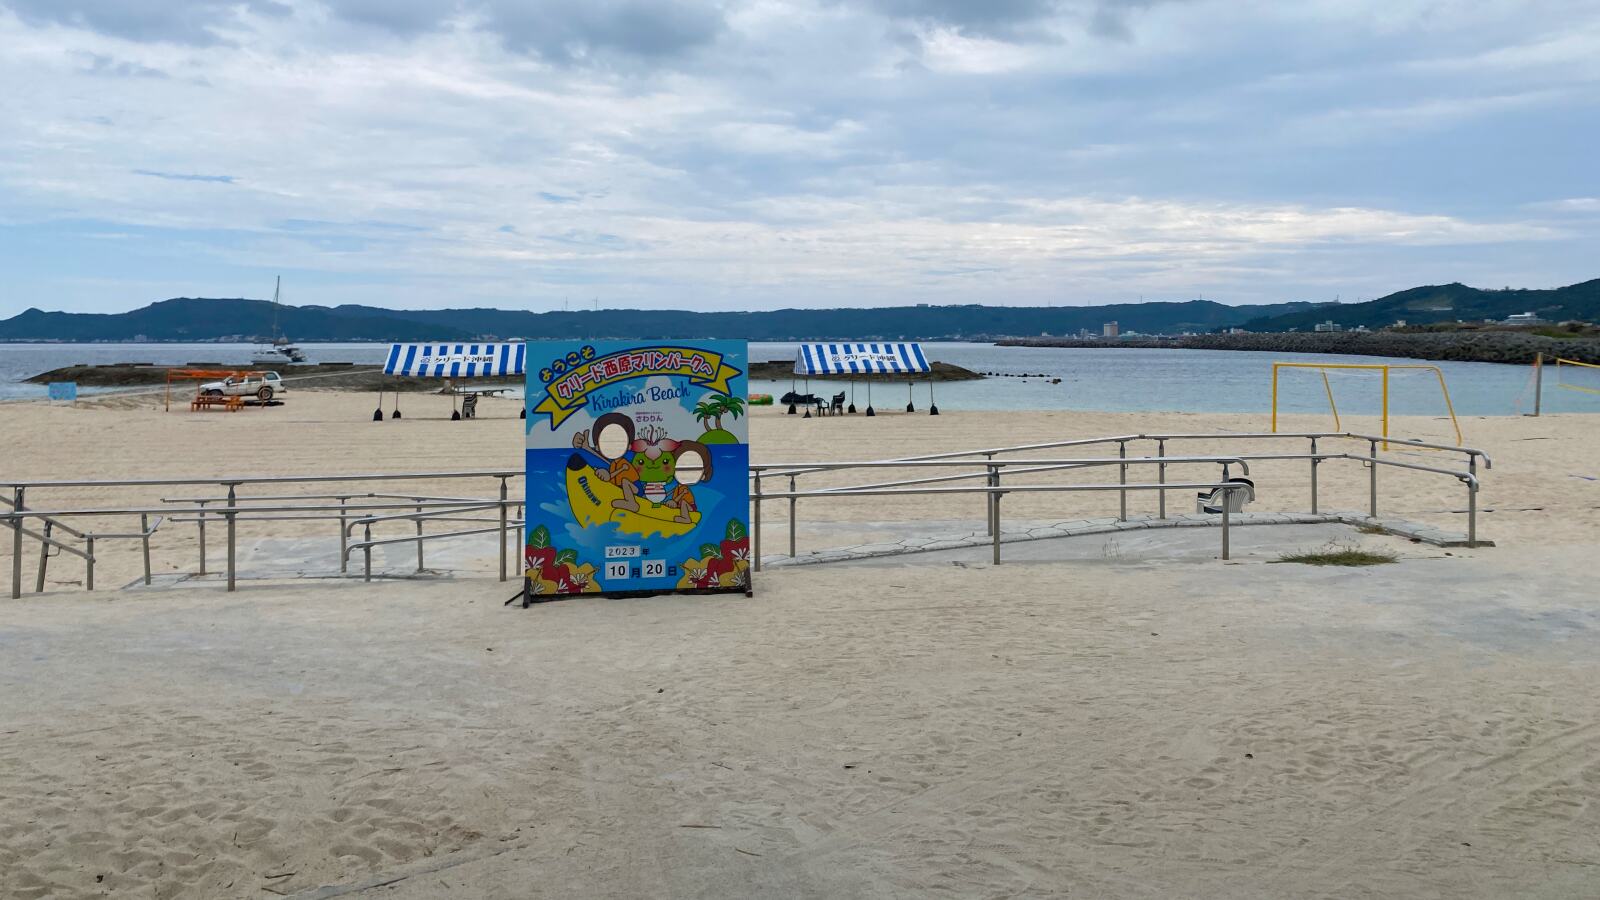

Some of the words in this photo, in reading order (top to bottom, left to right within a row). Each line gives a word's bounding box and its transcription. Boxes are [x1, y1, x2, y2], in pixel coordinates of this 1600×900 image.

[539, 345, 595, 382] ようこそ
[557, 353, 714, 398] クリード西原マリンパークへ
[592, 389, 646, 412] Kirakira
[647, 381, 691, 402] Beach
[635, 415, 663, 423] さわりん
[578, 475, 601, 506] Okinawa
[609, 547, 635, 556] 2023
[642, 548, 650, 556] 年
[610, 565, 626, 576] 10
[631, 567, 641, 578] 月
[646, 563, 663, 574] 20
[668, 566, 678, 577] 日
